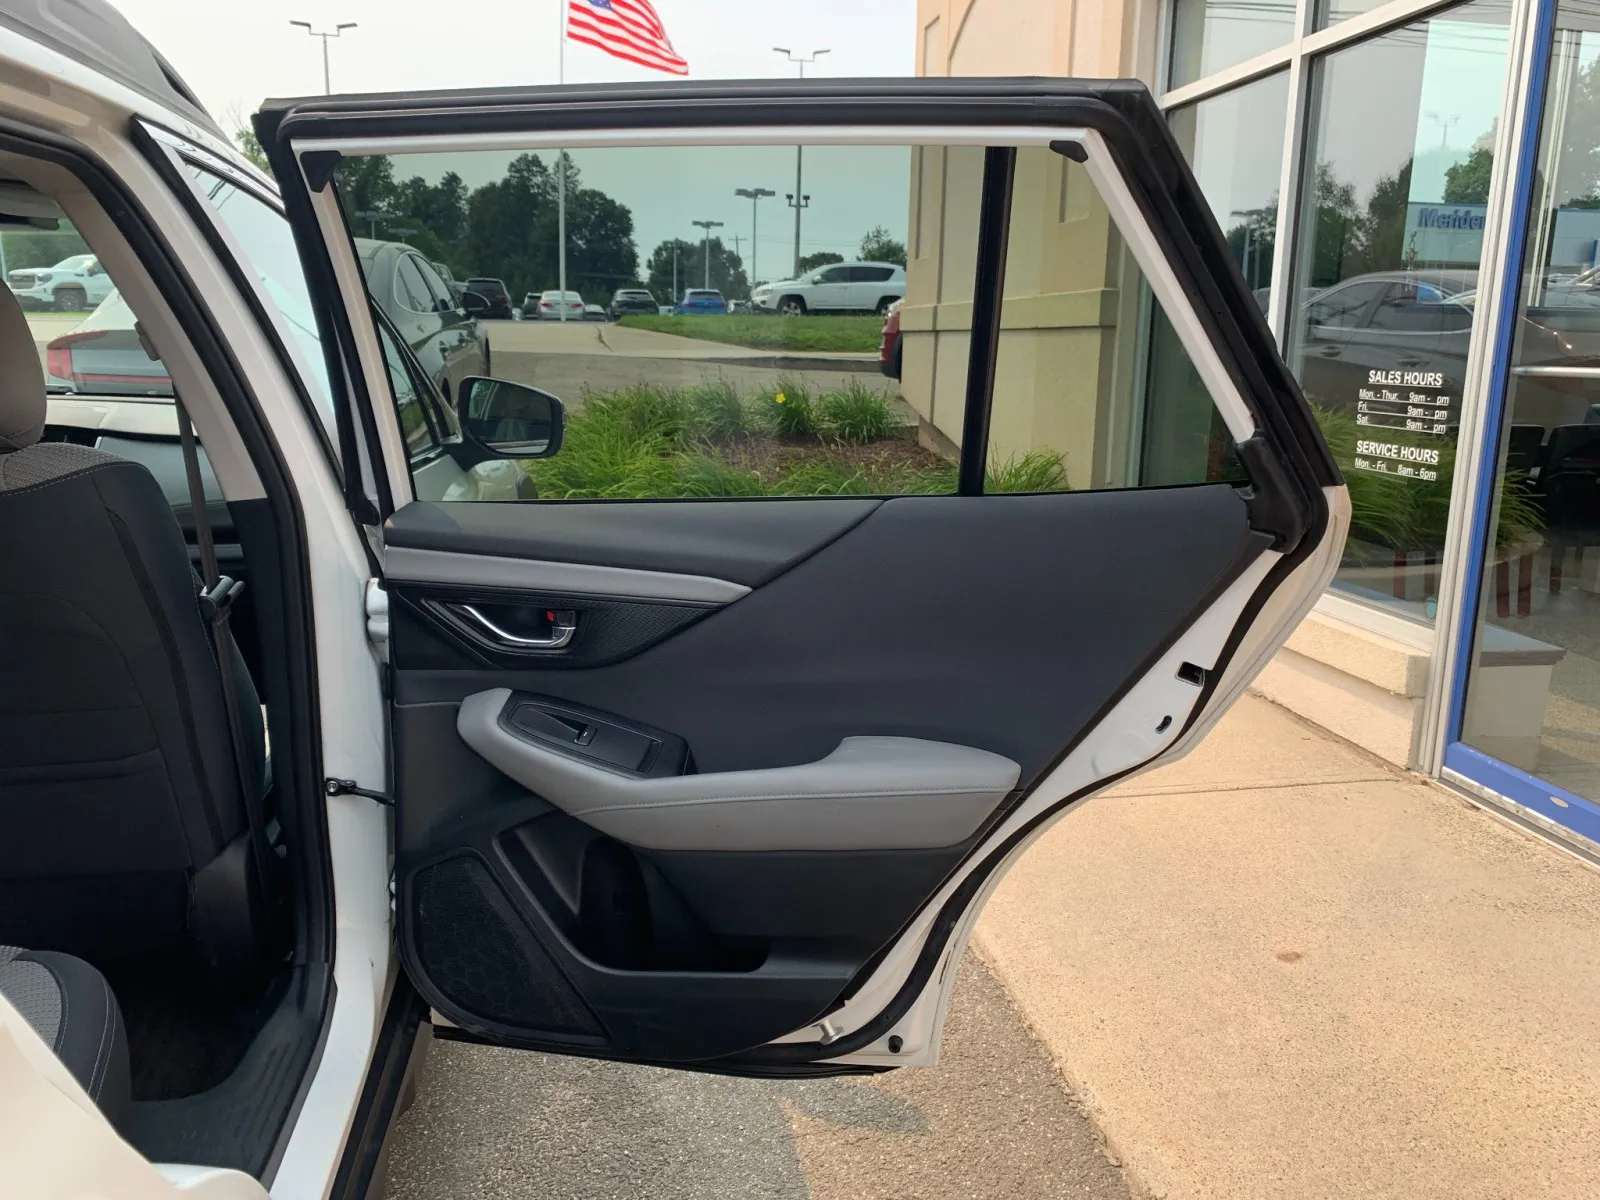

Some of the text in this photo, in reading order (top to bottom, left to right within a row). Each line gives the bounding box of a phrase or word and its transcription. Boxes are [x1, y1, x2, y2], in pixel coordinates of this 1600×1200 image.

[1368, 369, 1443, 386] SALES HOURS
[1409, 391, 1425, 403] 9am
[1407, 405, 1423, 416] 9am
[1406, 419, 1422, 430] 9am
[1356, 440, 1439, 463] SERVICE HOURS
[1397, 464, 1414, 476] 8am
[1419, 468, 1437, 481] 6pm
